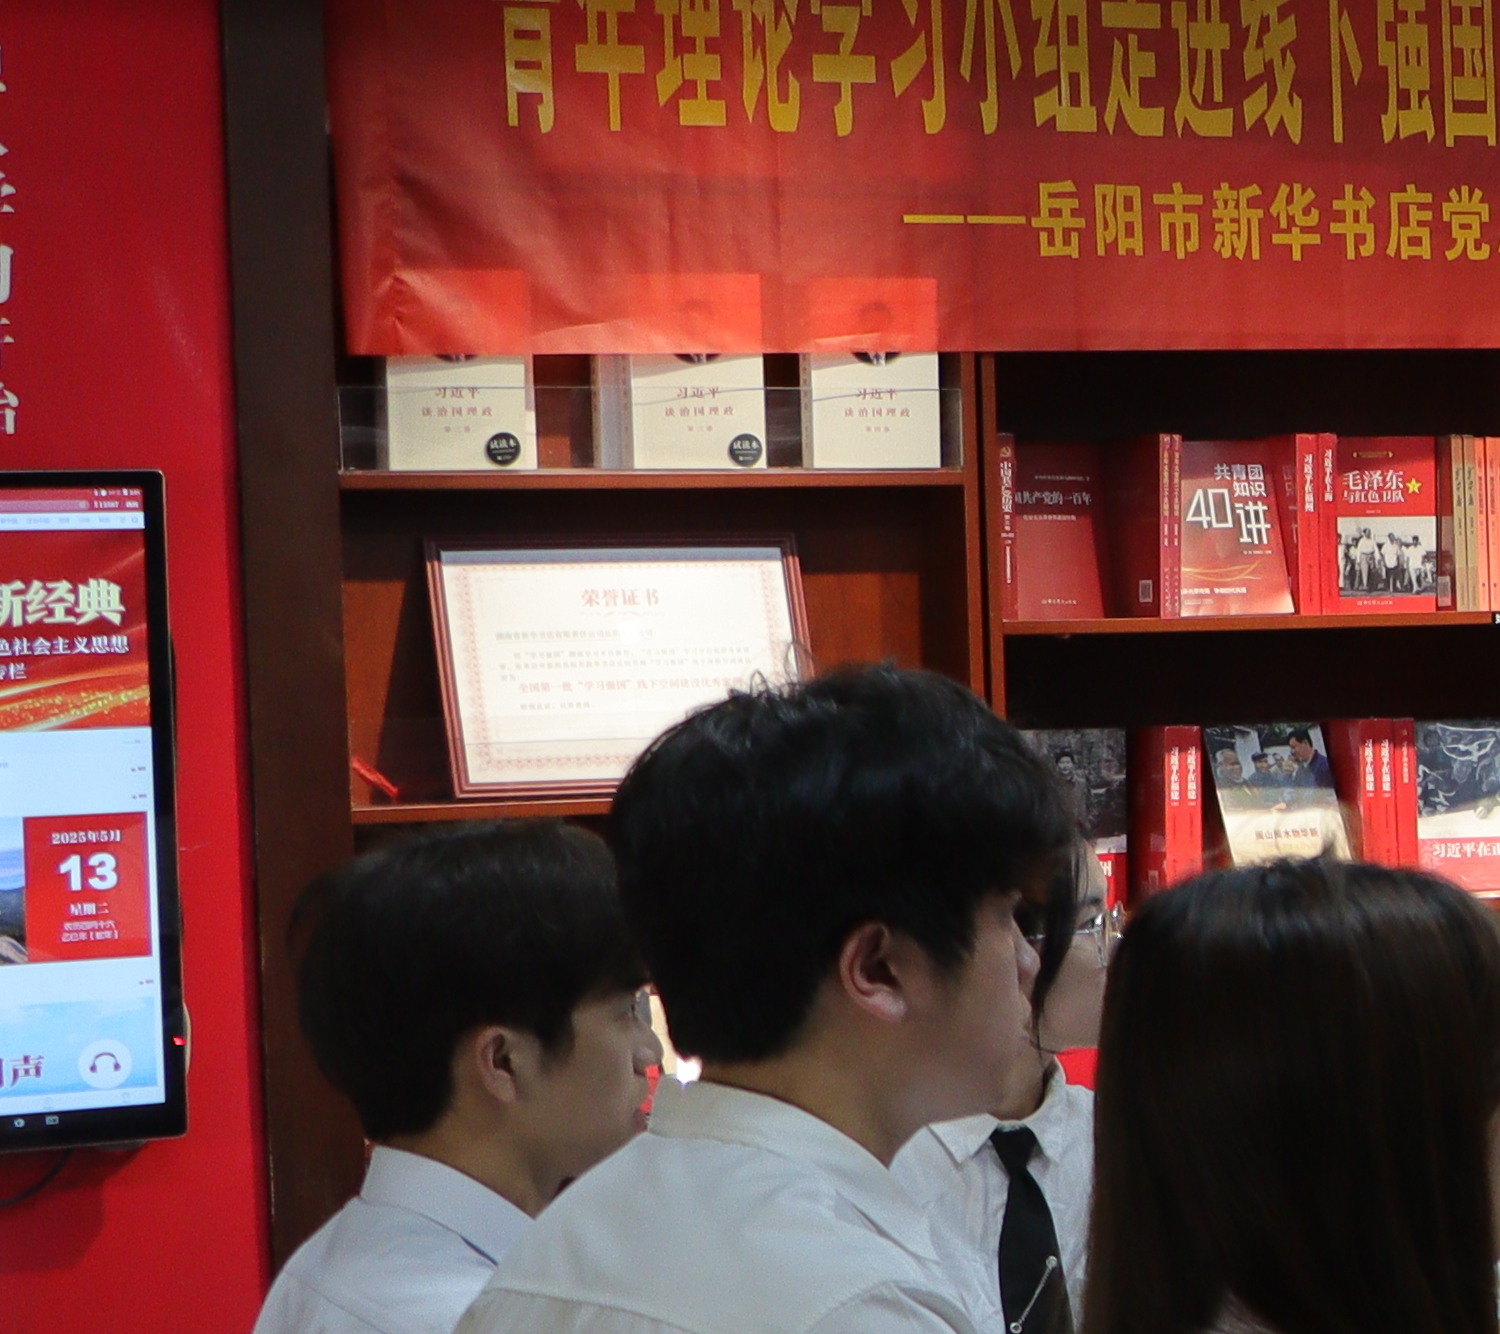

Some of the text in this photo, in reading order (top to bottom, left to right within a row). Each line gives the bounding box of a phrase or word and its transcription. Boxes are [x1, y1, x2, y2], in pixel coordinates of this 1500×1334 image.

[435, 386, 479, 400] 习近平
[676, 386, 719, 400] 习近平
[857, 387, 898, 401] 习近平
[421, 406, 493, 418] 谈治国理政
[665, 406, 735, 417] 谈治国理政
[844, 407, 911, 418] 谈治国理政
[1214, 463, 1264, 481] 共青团
[1343, 469, 1405, 491] 毛泽东
[1233, 481, 1267, 498] 知识
[1342, 490, 1406, 504] 与红色卫队
[581, 588, 660, 608] 荣誉证书
[59, 851, 118, 892] 13
